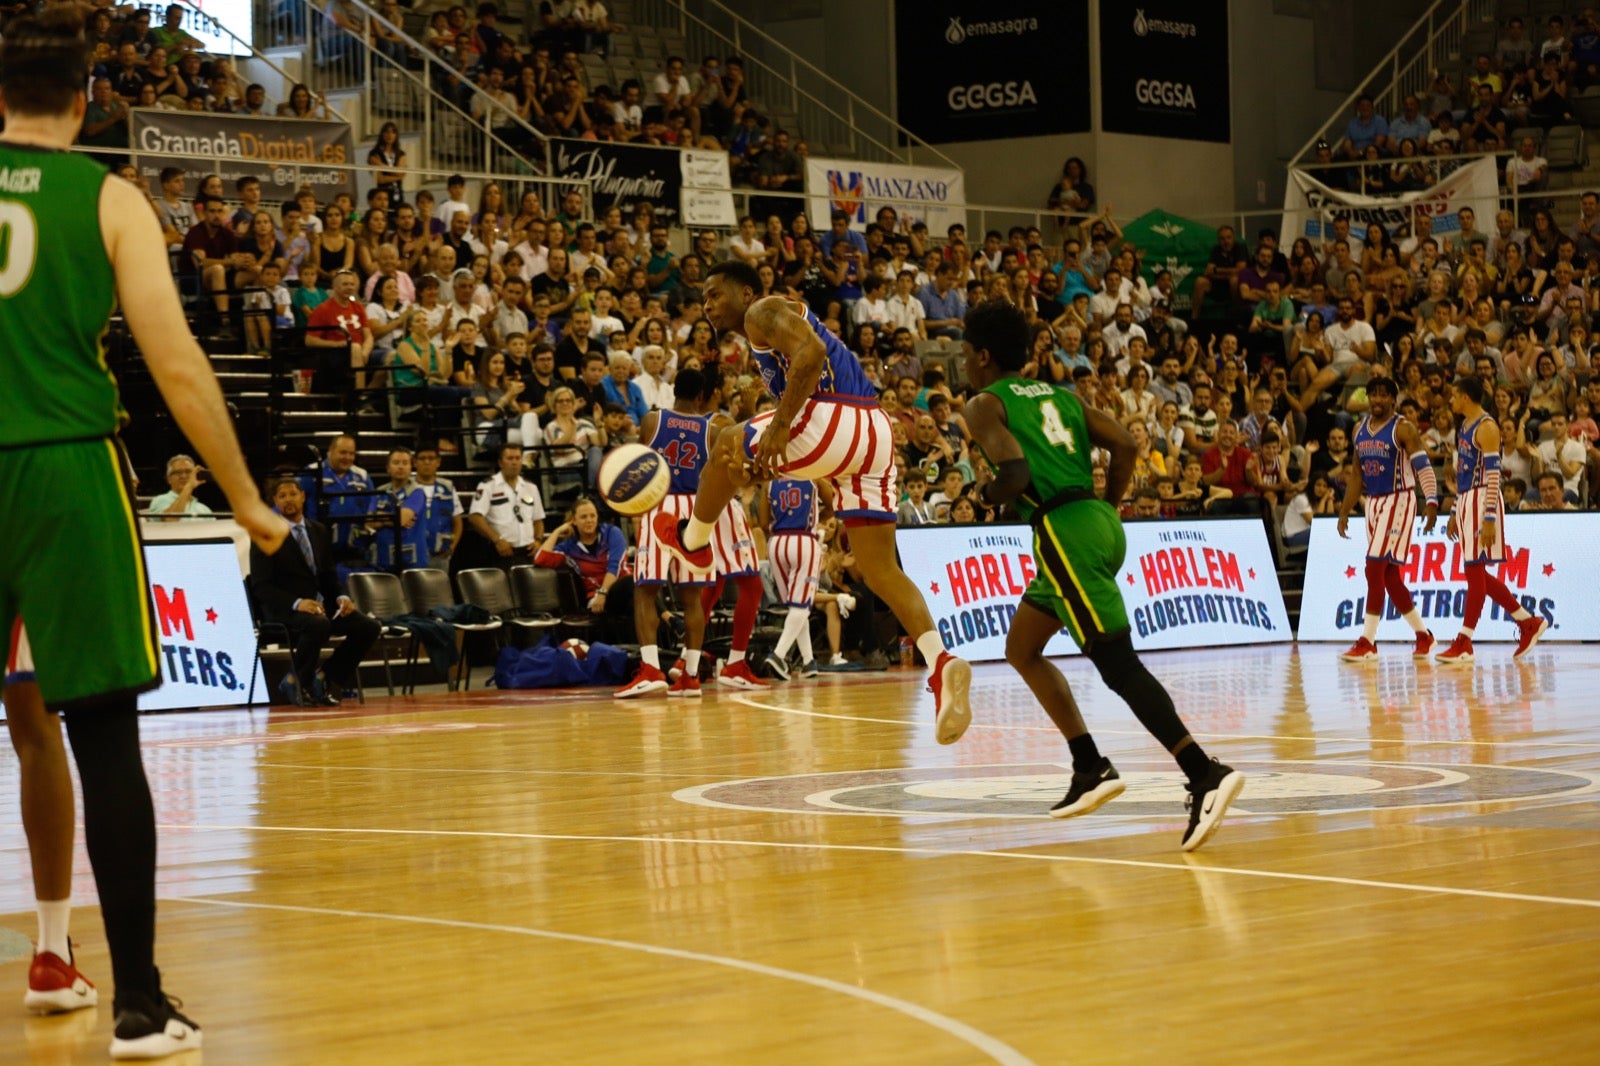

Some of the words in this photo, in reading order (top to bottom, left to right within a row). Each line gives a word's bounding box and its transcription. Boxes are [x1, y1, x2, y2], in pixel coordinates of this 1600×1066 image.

[966, 17, 1038, 36] emasagra
[1148, 17, 1197, 38] emasagra
[273, 168, 348, 186] @dporteGD
[866, 176, 948, 201] MANZANO
[667, 417, 701, 433] SPIDER
[1039, 399, 1077, 455] 4
[664, 439, 698, 470] 42
[1364, 459, 1381, 477] 23
[779, 487, 801, 512] 10
[969, 535, 983, 549] THE
[985, 535, 1024, 548] ORIGINAL
[1158, 532, 1172, 542] THE
[1173, 530, 1207, 543] ORIGINAL
[946, 553, 1038, 607] HARLE
[1139, 546, 1245, 597] HARLEM
